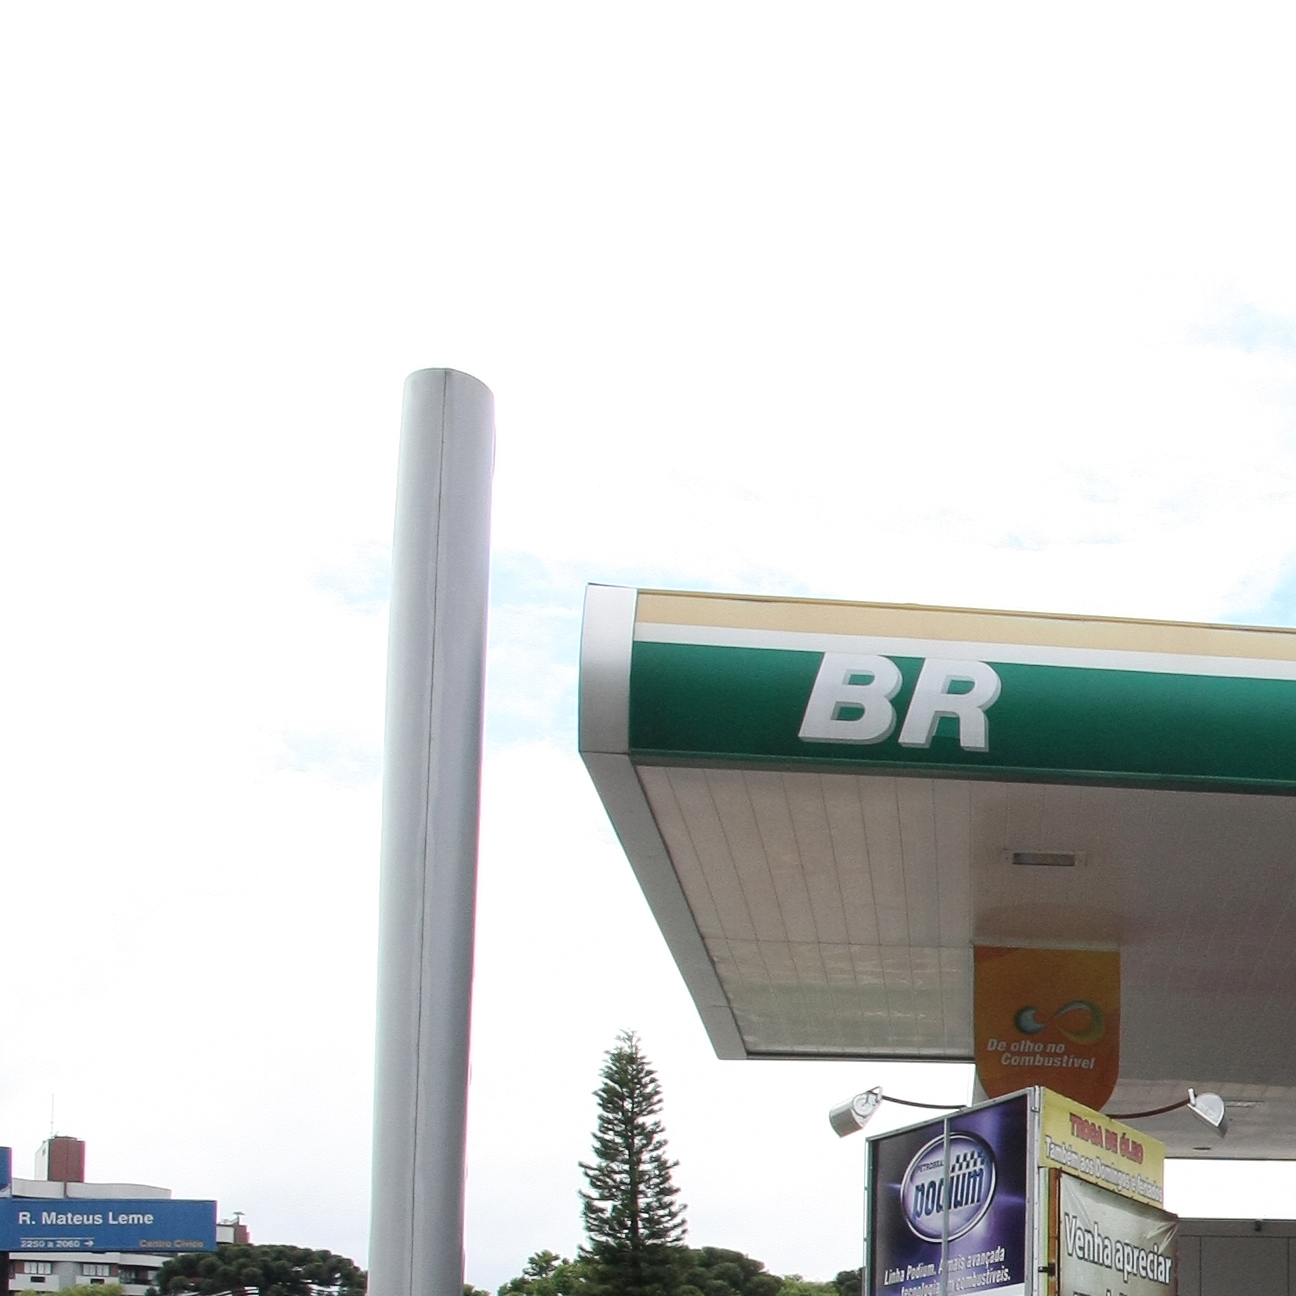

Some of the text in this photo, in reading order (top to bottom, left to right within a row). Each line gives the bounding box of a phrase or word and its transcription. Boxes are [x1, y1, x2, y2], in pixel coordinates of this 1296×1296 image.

[798, 652, 1001, 752] BR
[987, 1039, 1065, 1054] De olho no
[1001, 1053, 1096, 1070] Combustível
[1045, 1135, 1079, 1170] Também
[18, 1211, 154, 1225] R. Mateus Leme
[1065, 1211, 1172, 1283] Venha apreciar
[884, 1266, 905, 1285] Linha
